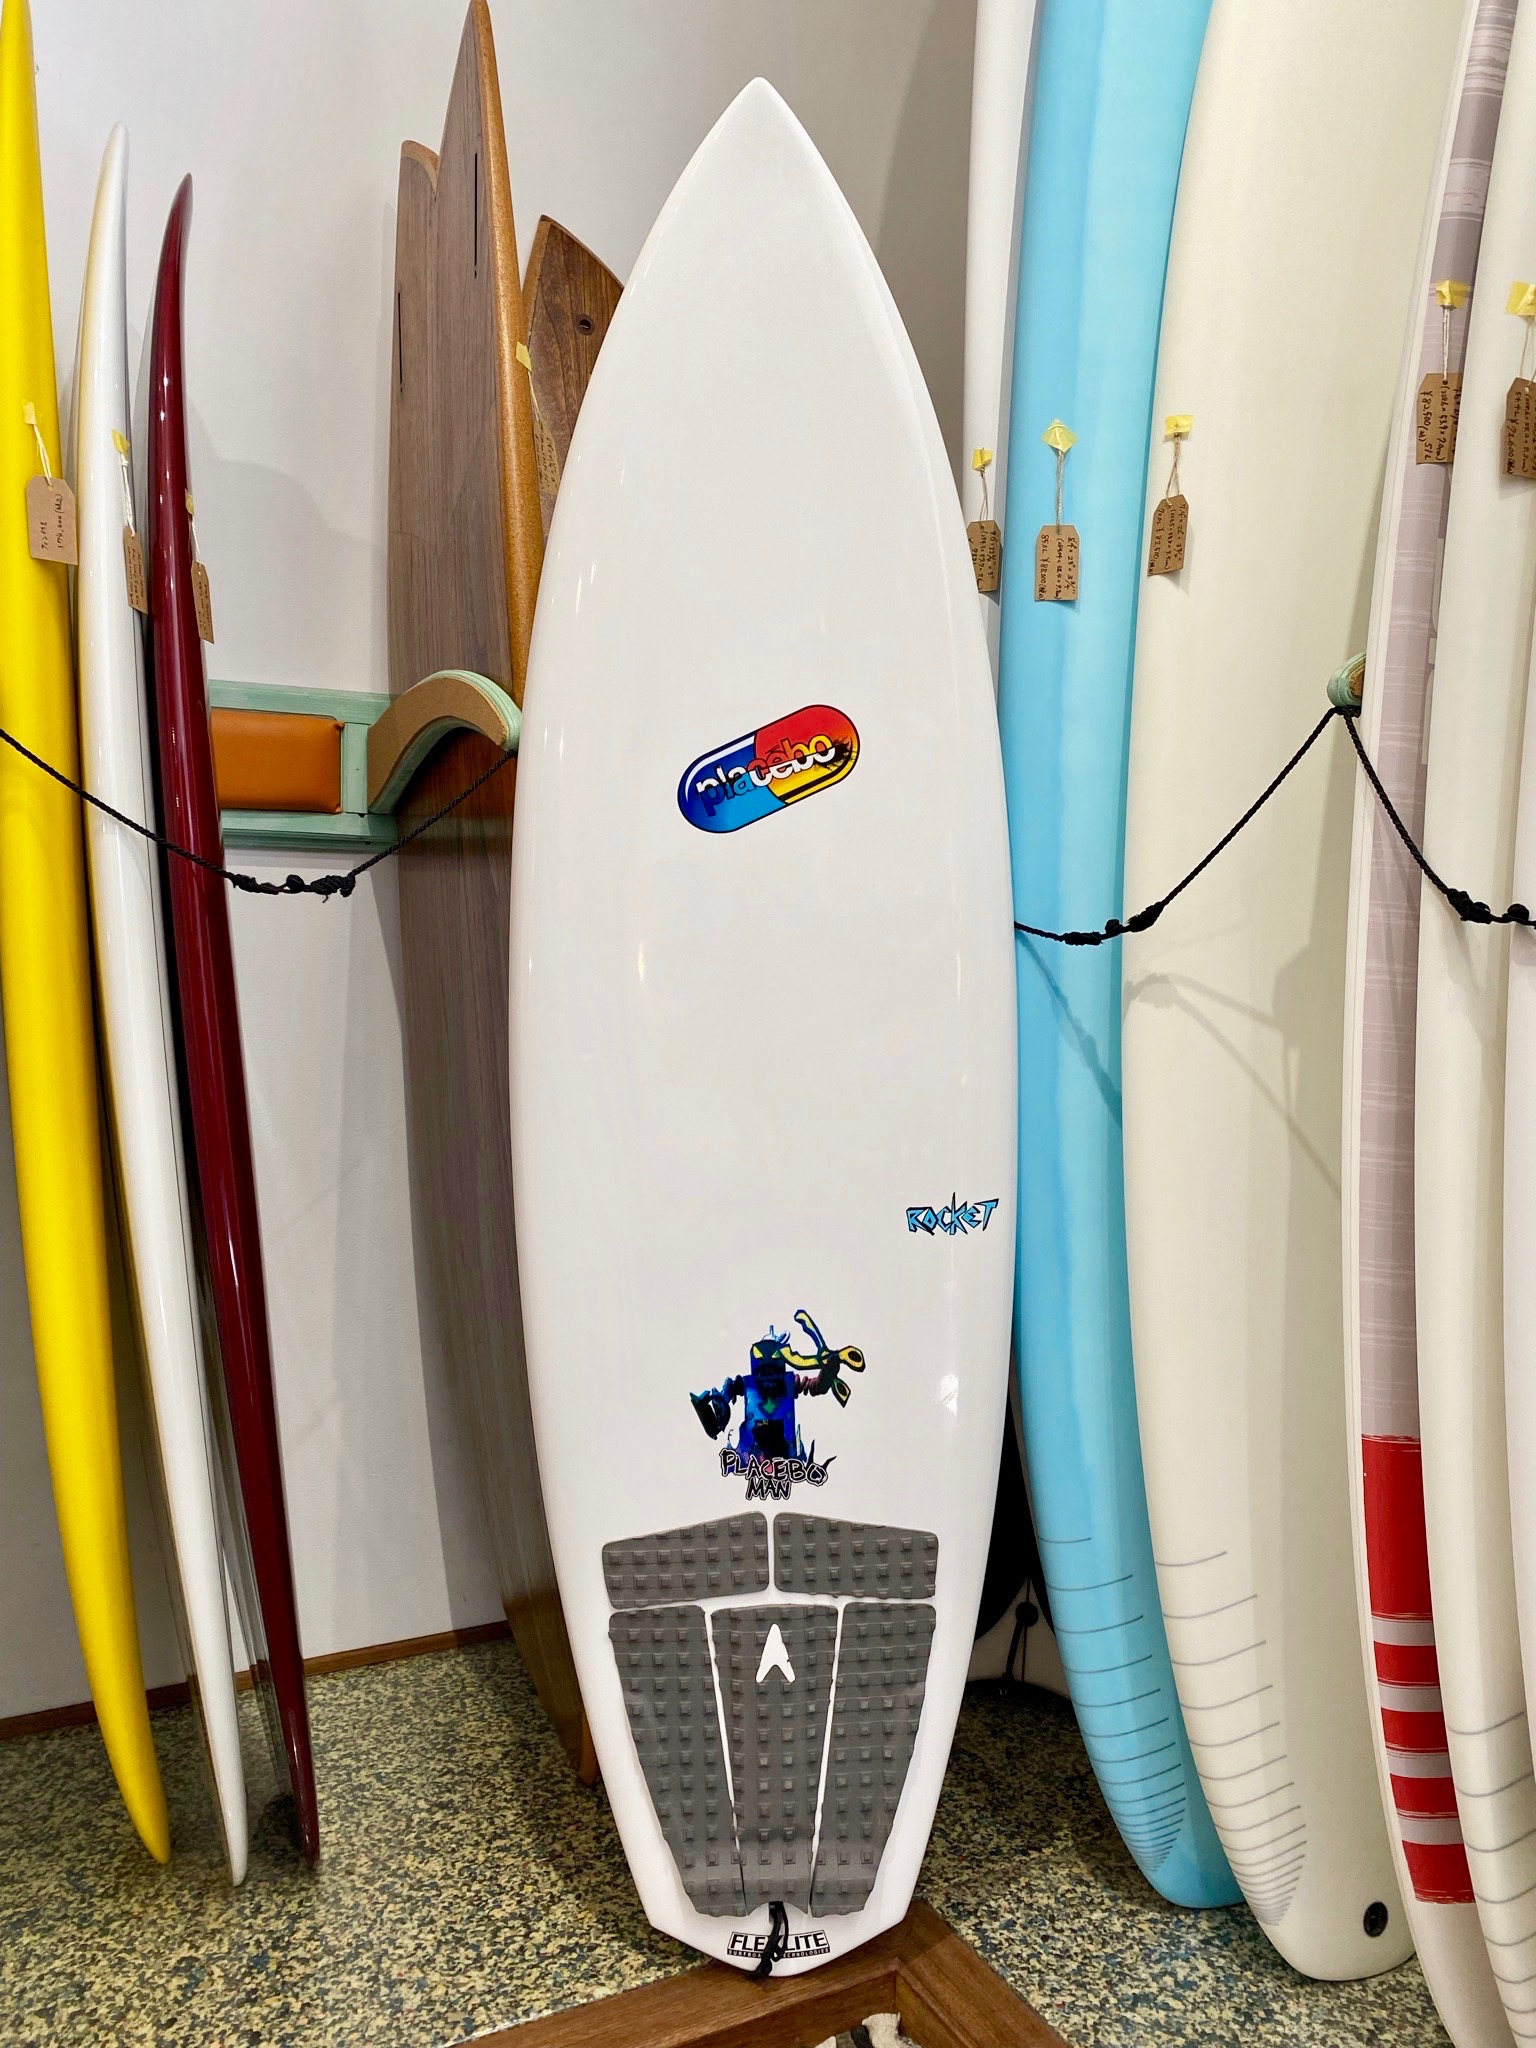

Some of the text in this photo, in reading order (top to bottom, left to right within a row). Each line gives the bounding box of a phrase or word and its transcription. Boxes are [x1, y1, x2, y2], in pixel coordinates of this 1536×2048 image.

[906, 1192, 999, 1236] ROCKET
[745, 1476, 792, 1500] MAN
[731, 1933, 827, 1951] FLELITE
